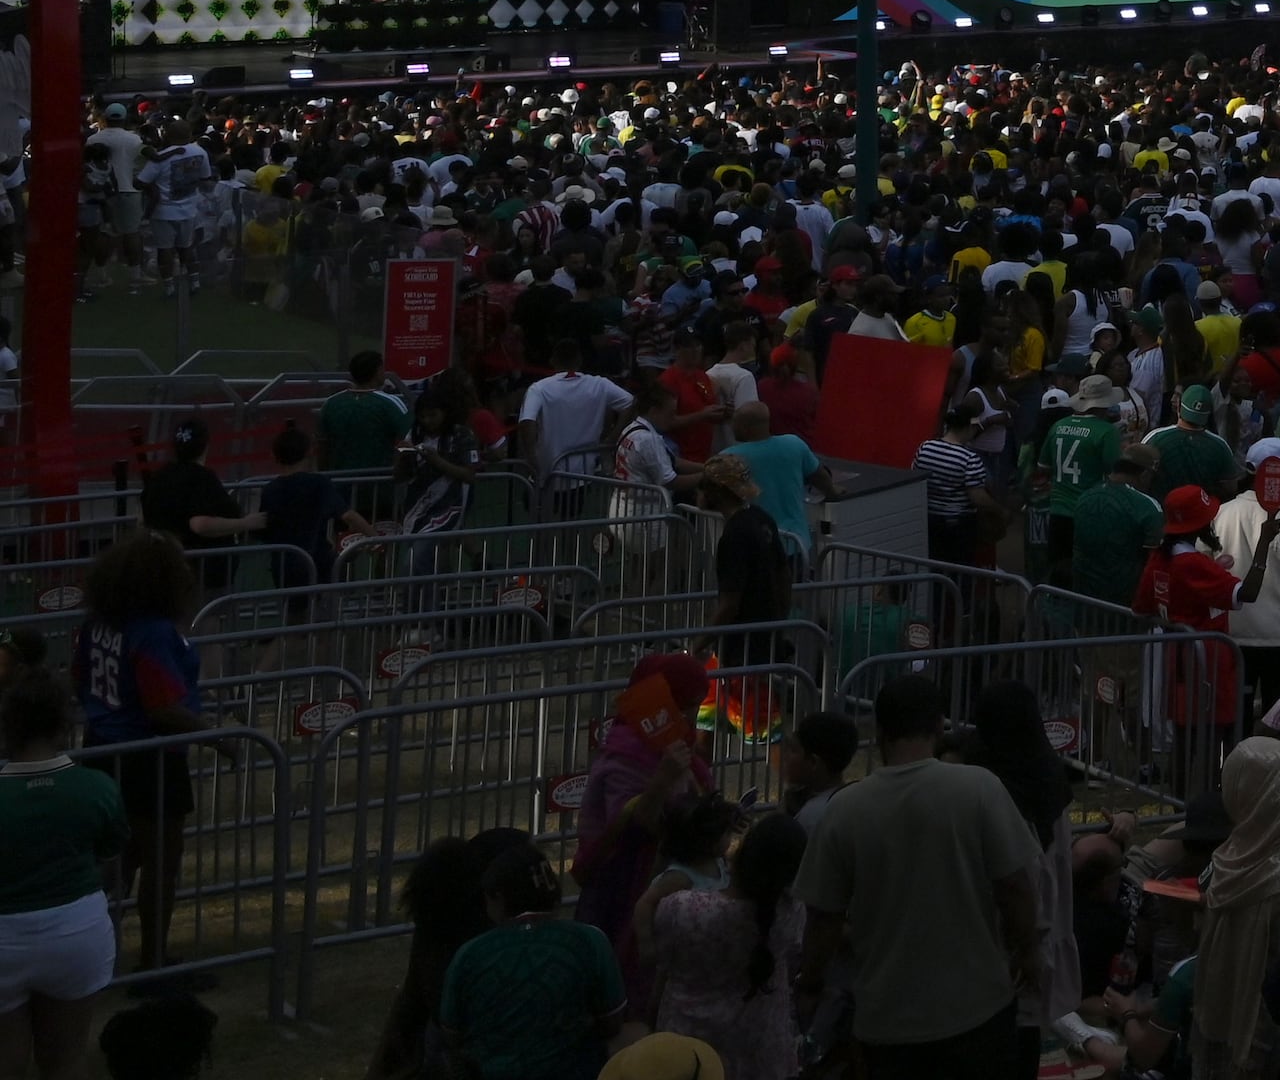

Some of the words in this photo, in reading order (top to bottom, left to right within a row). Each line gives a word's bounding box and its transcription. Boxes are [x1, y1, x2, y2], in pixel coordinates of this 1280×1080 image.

[1055, 437, 1082, 485] 14
[90, 623, 123, 657] USA
[90, 647, 122, 707] 26
